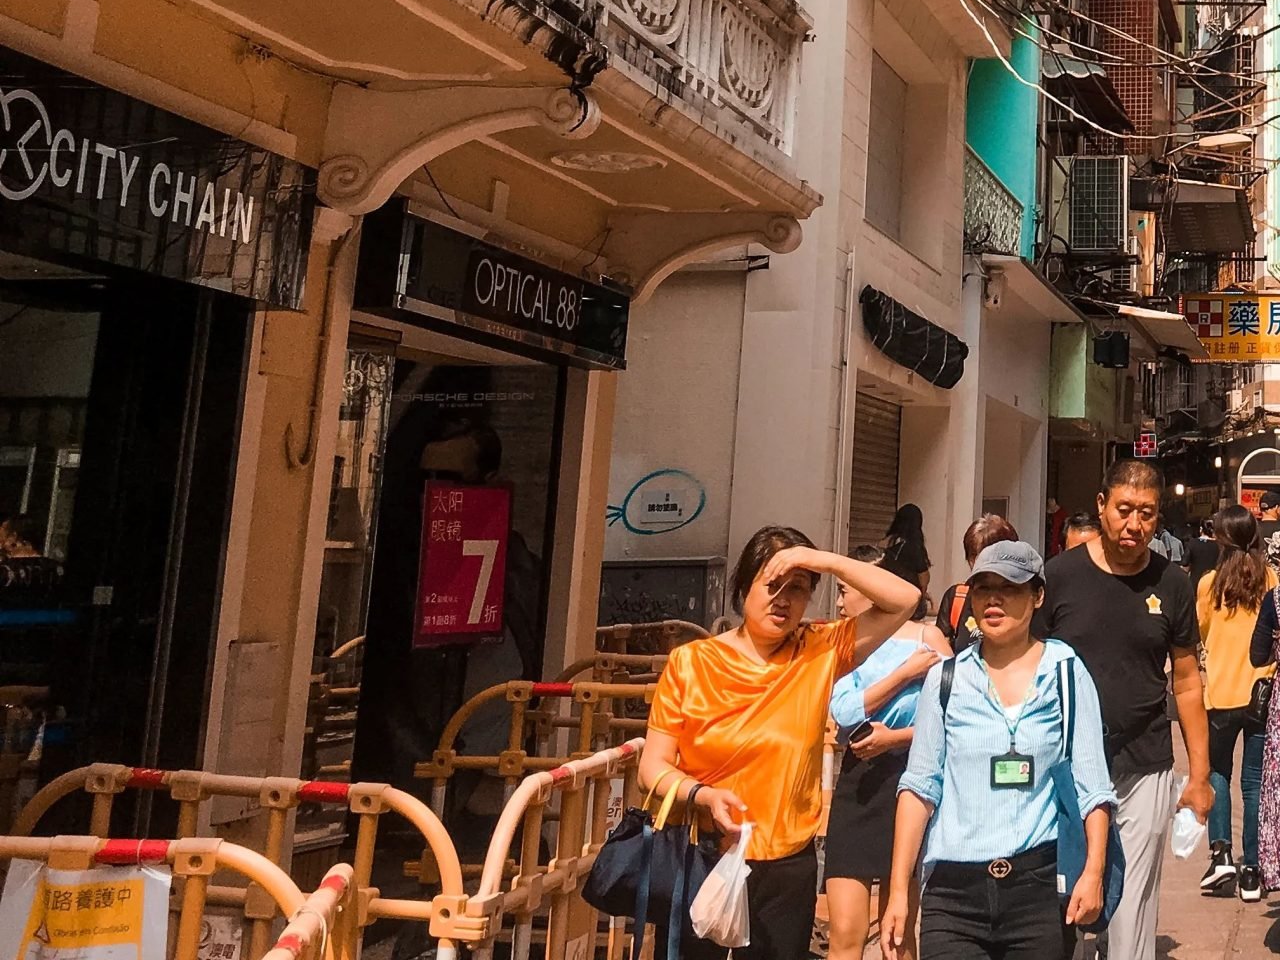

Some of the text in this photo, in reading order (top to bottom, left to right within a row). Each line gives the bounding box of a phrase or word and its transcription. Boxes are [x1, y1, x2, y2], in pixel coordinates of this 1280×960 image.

[50, 129, 254, 244] CITY CHAIN
[475, 258, 552, 325] OPTICAL
[556, 286, 577, 331] 88
[473, 391, 535, 401] DESIGN
[432, 491, 463, 513] 太阳
[431, 520, 462, 542] 眼镜
[463, 540, 498, 624] 7
[484, 605, 498, 623] 折
